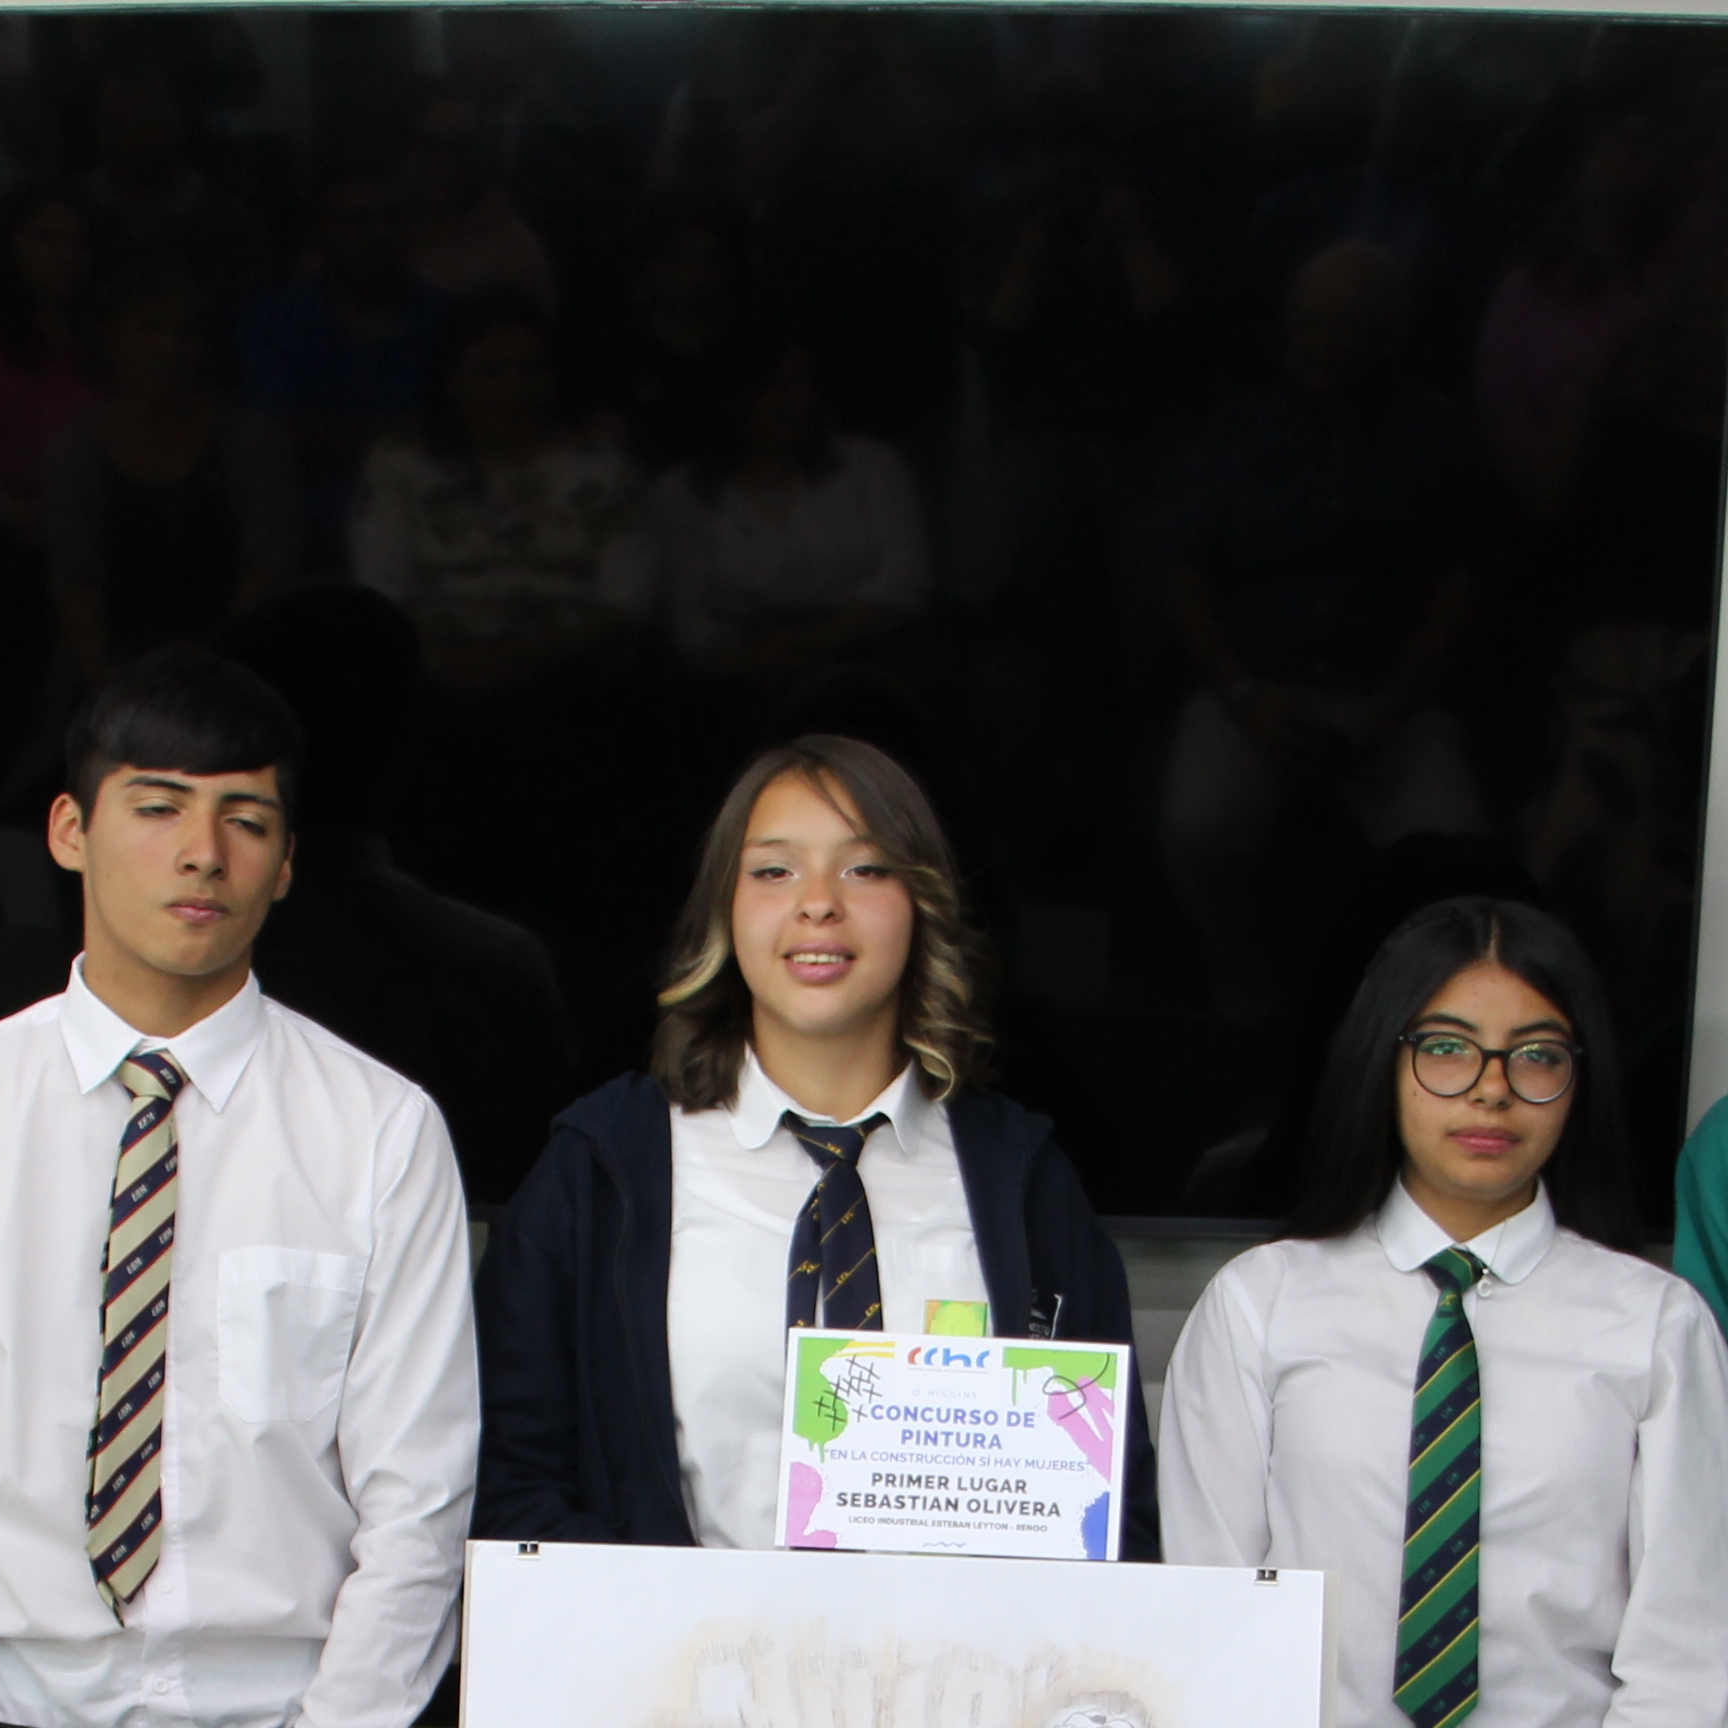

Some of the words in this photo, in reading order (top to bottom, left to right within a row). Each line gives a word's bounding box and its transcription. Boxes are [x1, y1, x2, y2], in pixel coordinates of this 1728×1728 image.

[870, 1404, 1000, 1427] CONCURSO
[1006, 1410, 1036, 1428] DE
[900, 1429, 1003, 1450] PINTURA
[851, 1450, 868, 1462] LA
[870, 1450, 976, 1468] CONSTRUCCIÓN
[978, 1454, 992, 1468] SÍ
[994, 1458, 1022, 1469] HAY
[871, 1472, 950, 1491] PRIMER
[956, 1476, 1028, 1495] LUGAR
[836, 1492, 960, 1512] SEBASTIAN
[966, 1497, 1062, 1518] OLIVERA
[848, 1516, 876, 1524] LICEO
[877, 1516, 929, 1527] INDUSTRIAL
[931, 1519, 971, 1529] ESTEBAN
[973, 1521, 1008, 1531] LEYTON
[1016, 1523, 1048, 1533] RENGO
